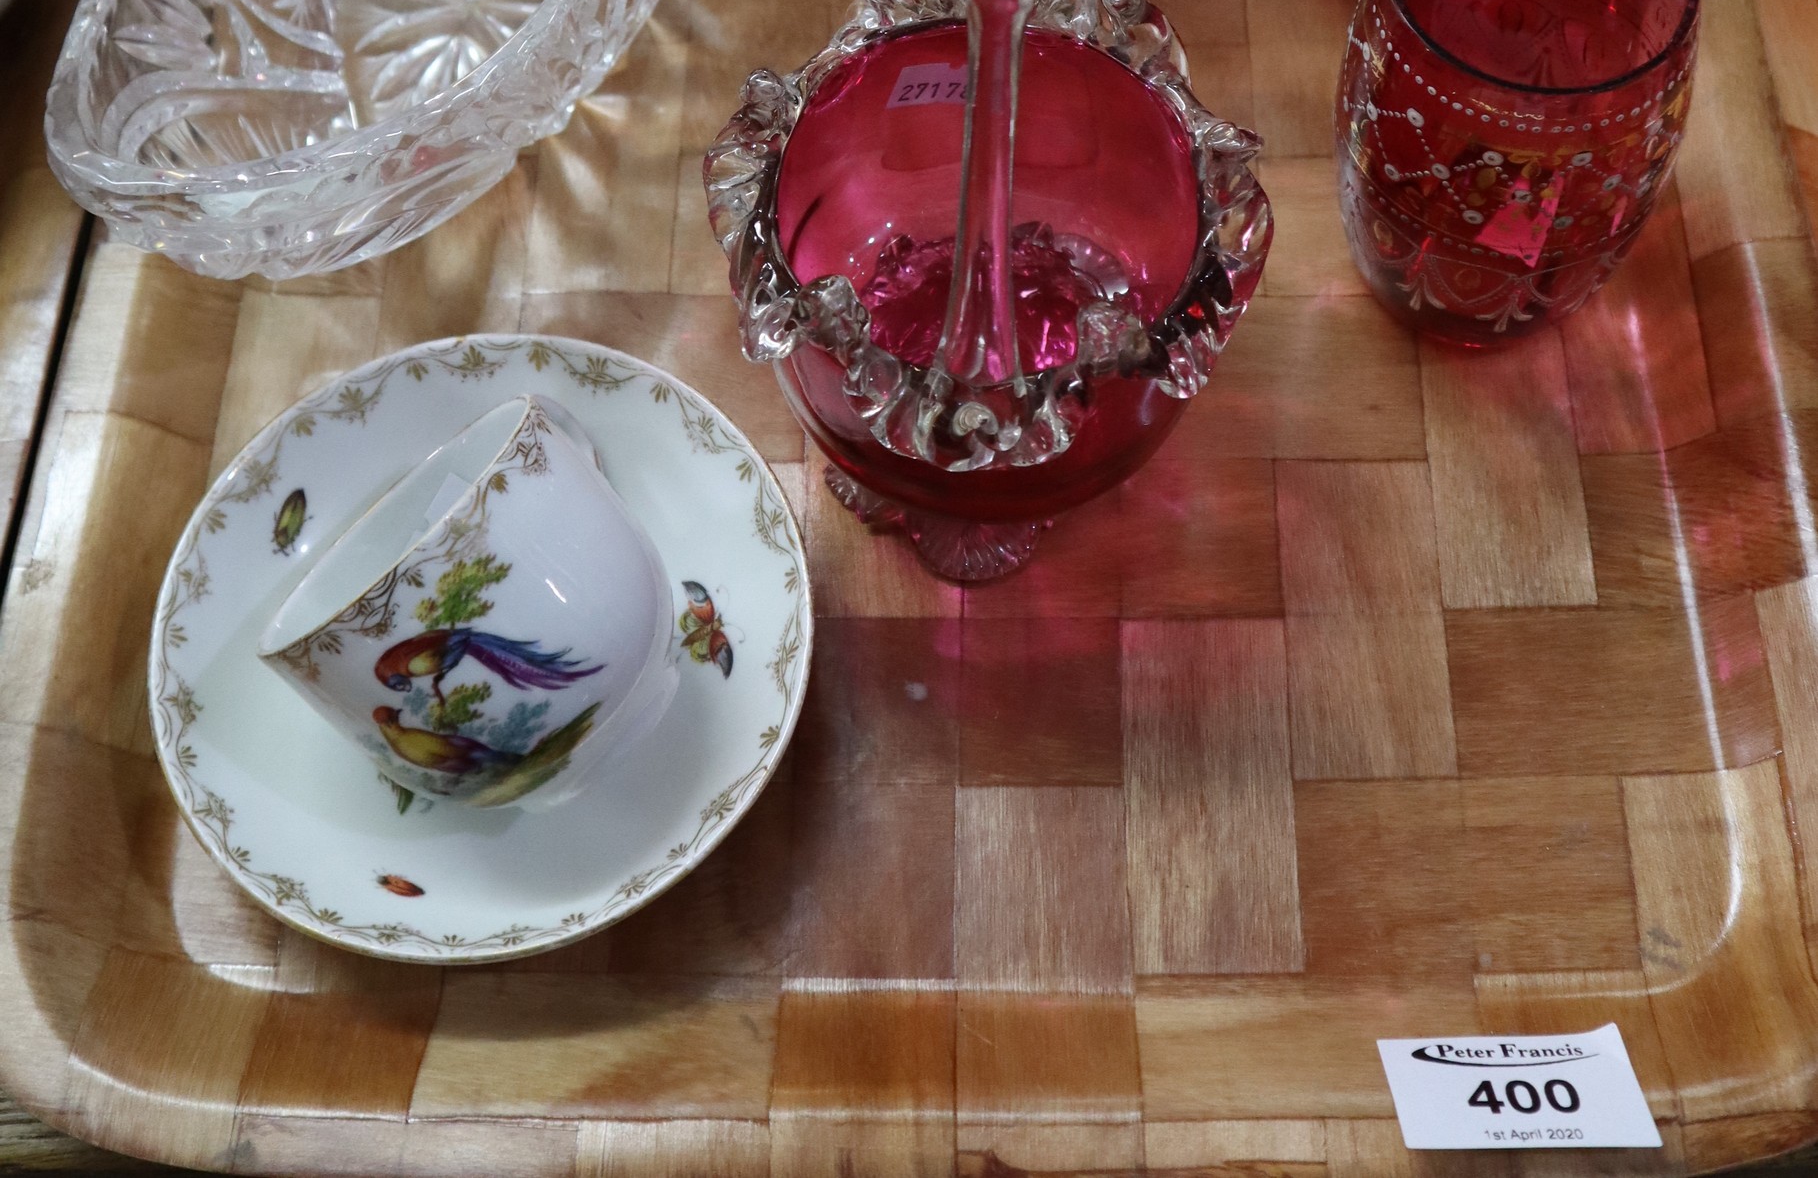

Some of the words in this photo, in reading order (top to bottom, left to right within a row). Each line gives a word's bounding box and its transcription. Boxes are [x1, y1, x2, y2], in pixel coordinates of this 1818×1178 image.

[1435, 1044, 1495, 1059] Peter
[1498, 1043, 1584, 1058] Francis
[1467, 1079, 1581, 1114] 400
[1485, 1129, 1505, 1141] 1st
[1510, 1128, 1543, 1142] April
[1549, 1128, 1584, 1140] 2020
